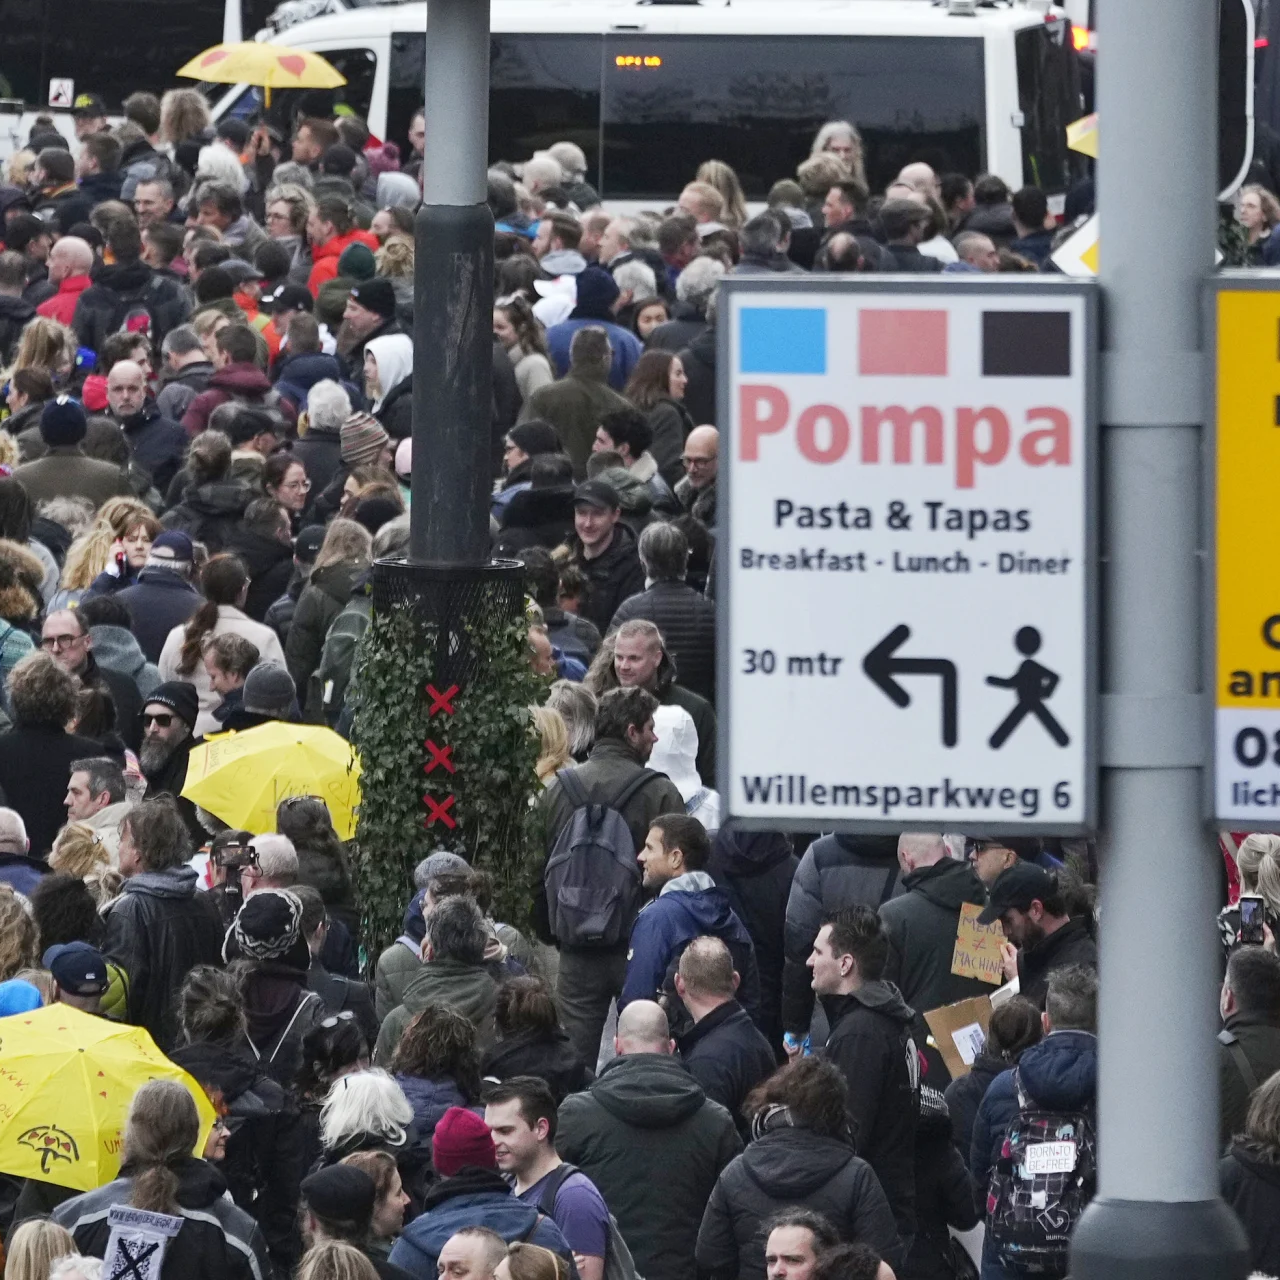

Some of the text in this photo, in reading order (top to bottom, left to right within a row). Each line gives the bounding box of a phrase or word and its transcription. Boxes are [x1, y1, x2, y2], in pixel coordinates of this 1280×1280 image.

[739, 383, 1072, 488] Pompa
[775, 500, 1031, 535] Pasta & Tapas
[740, 548, 866, 573] Breakfast
[893, 550, 970, 574] Lunch
[998, 552, 1072, 575] Diner
[742, 649, 844, 677] 30 mtr
[742, 775, 1071, 818] Willemsparkweg 6
[1028, 1158, 1071, 1171] BE FREE
[1029, 1145, 1072, 1159] BORN TO
